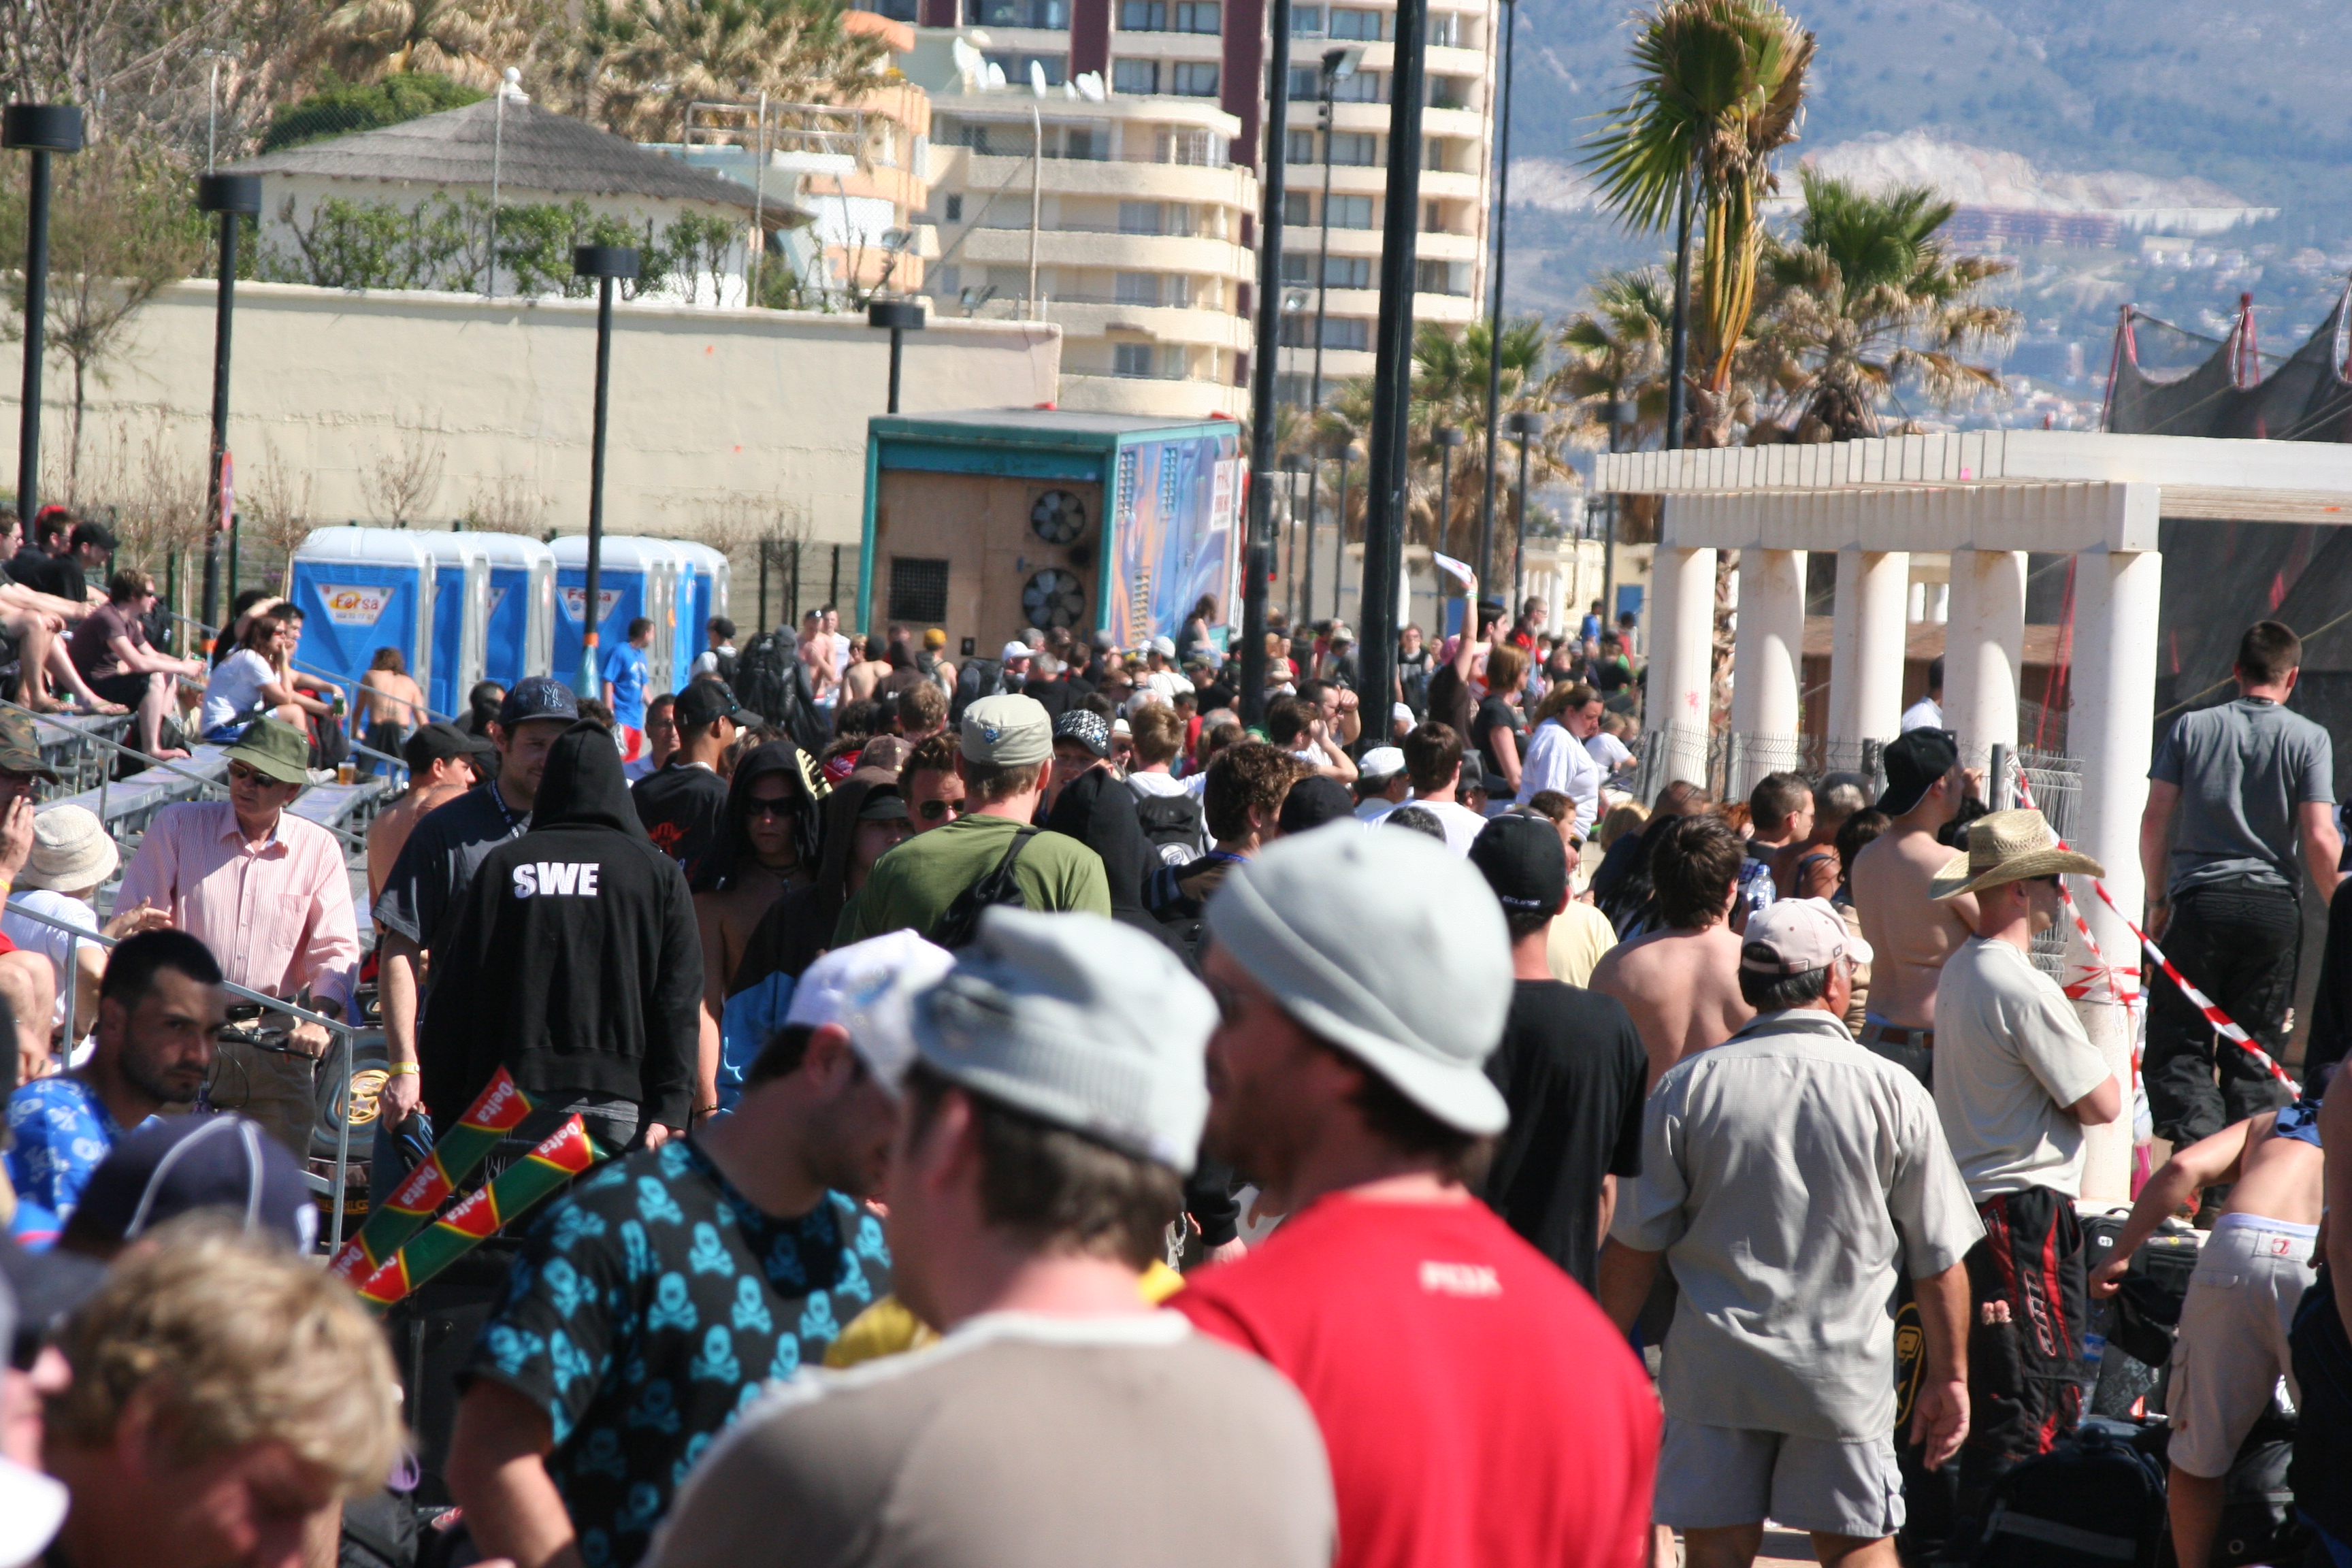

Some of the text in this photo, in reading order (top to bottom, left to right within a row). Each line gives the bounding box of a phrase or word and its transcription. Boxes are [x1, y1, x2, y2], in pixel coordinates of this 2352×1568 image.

[336, 592, 379, 610] Fersa
[567, 588, 611, 601] Fea
[542, 683, 563, 707] NY
[512, 862, 600, 898] SWE
[477, 1081, 514, 1122] Delta
[538, 1122, 579, 1154] Delta
[402, 1166, 438, 1205] Delta
[446, 1189, 487, 1221] Delta
